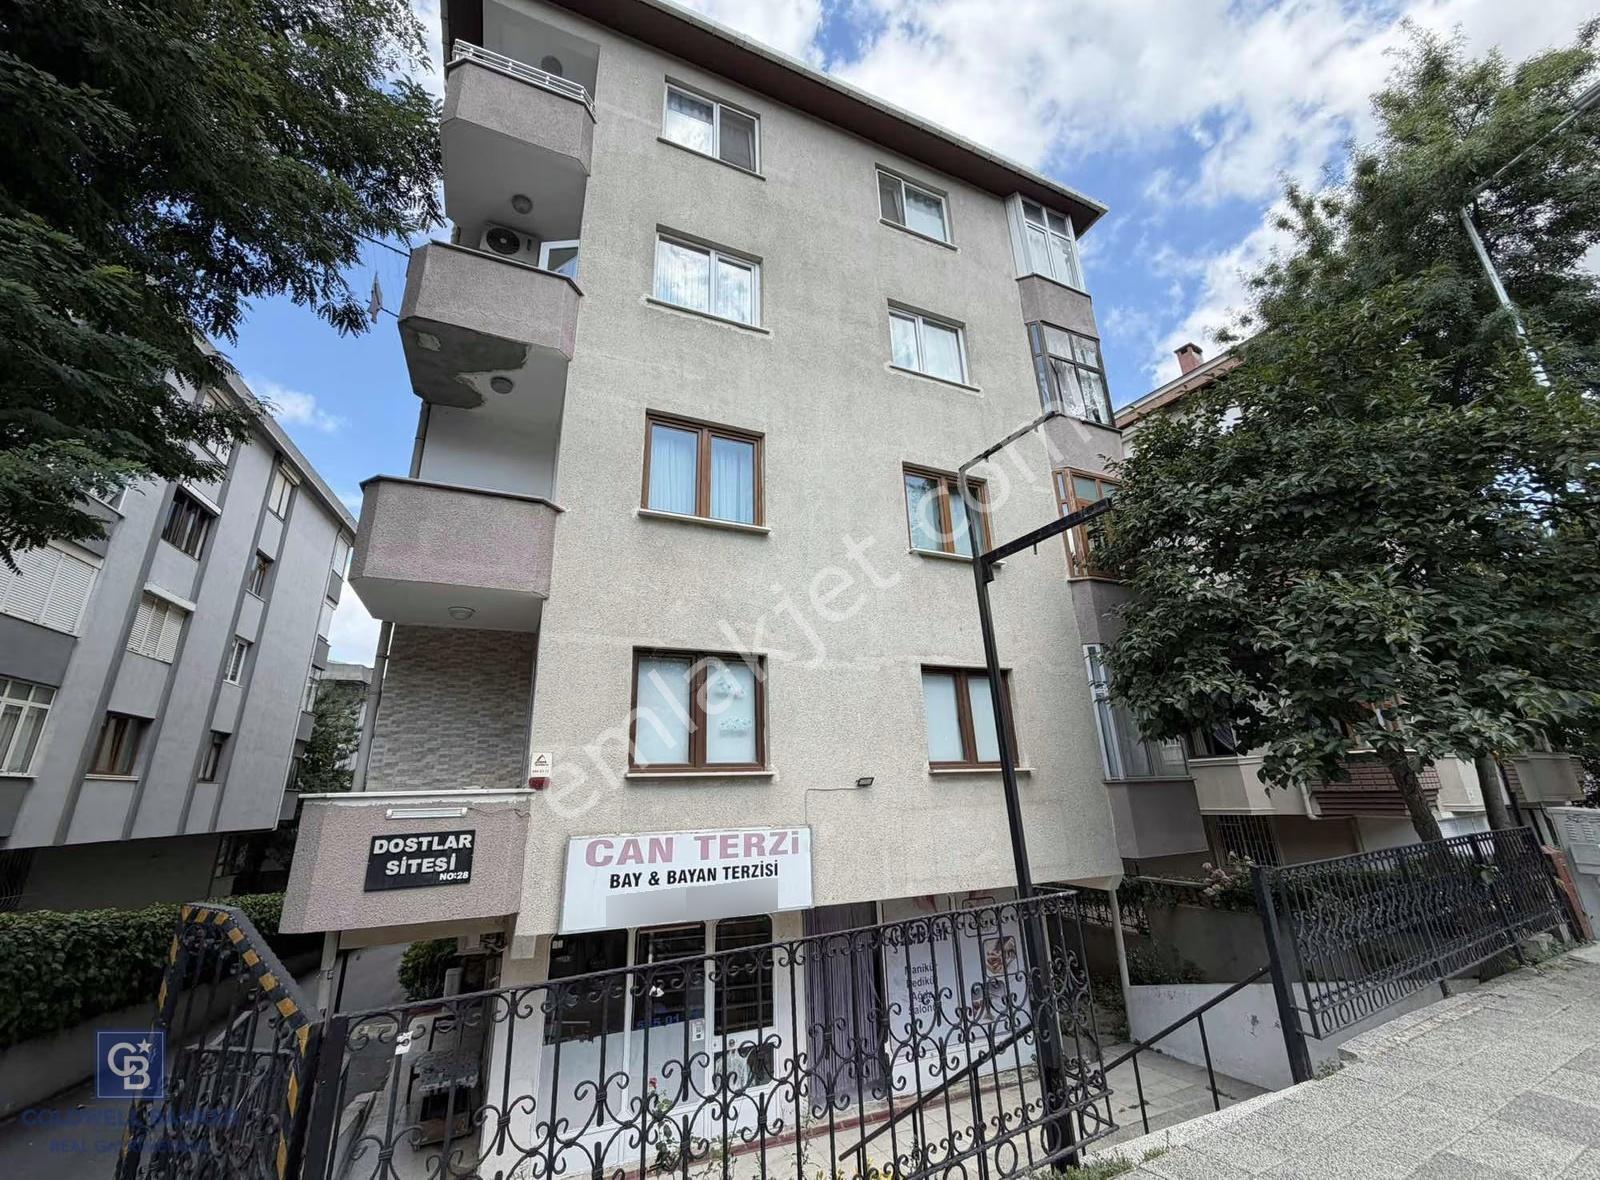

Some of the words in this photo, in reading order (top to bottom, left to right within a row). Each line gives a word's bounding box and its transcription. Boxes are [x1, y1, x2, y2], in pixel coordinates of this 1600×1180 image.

[373, 834, 472, 855] DOSTLAR
[585, 837, 674, 867] CAN
[385, 853, 457, 876] SİTESİ
[439, 871, 469, 881] NO:28
[609, 872, 643, 889] BAY
[648, 871, 660, 886] &
[666, 868, 717, 885] BAYAN
[723, 860, 778, 881] TERZİSİ
